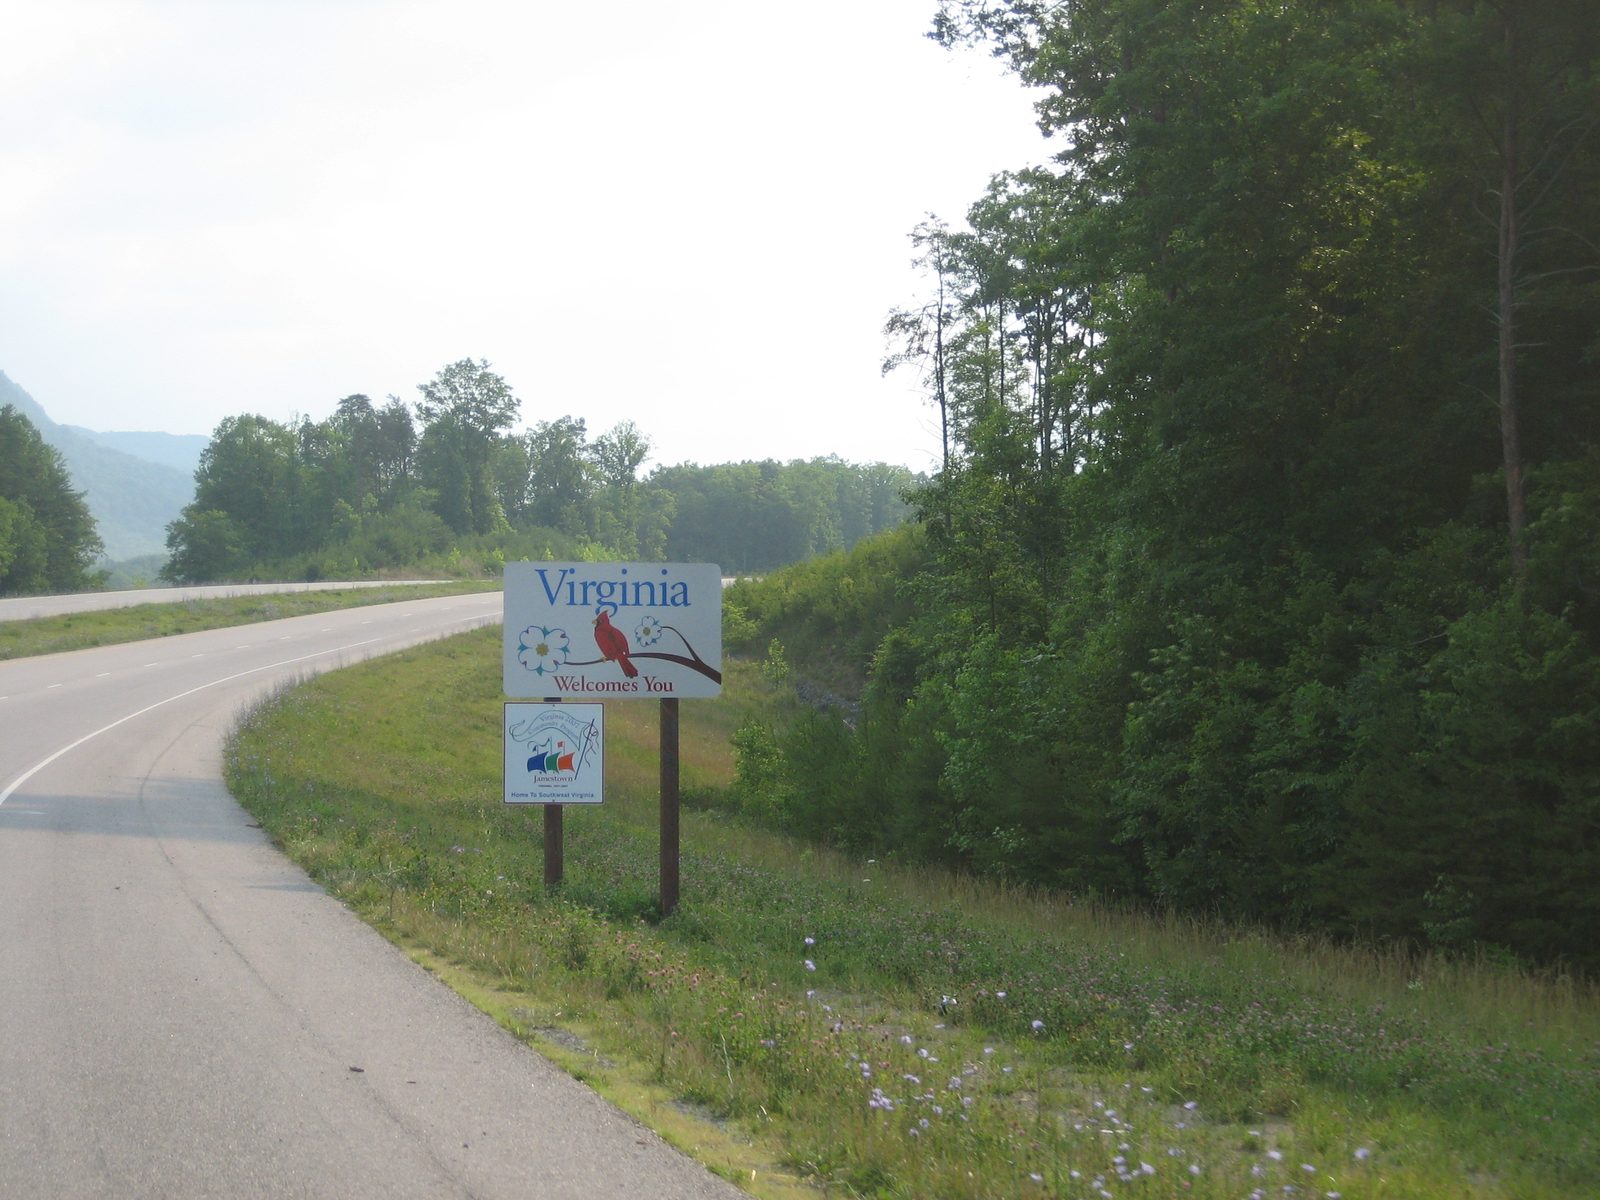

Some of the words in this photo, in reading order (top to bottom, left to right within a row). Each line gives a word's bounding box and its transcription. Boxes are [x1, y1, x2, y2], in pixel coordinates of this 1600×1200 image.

[535, 568, 691, 617] Virginia
[553, 675, 638, 692] Welcomes
[643, 676, 673, 692] You
[534, 774, 573, 783] Jamestown
